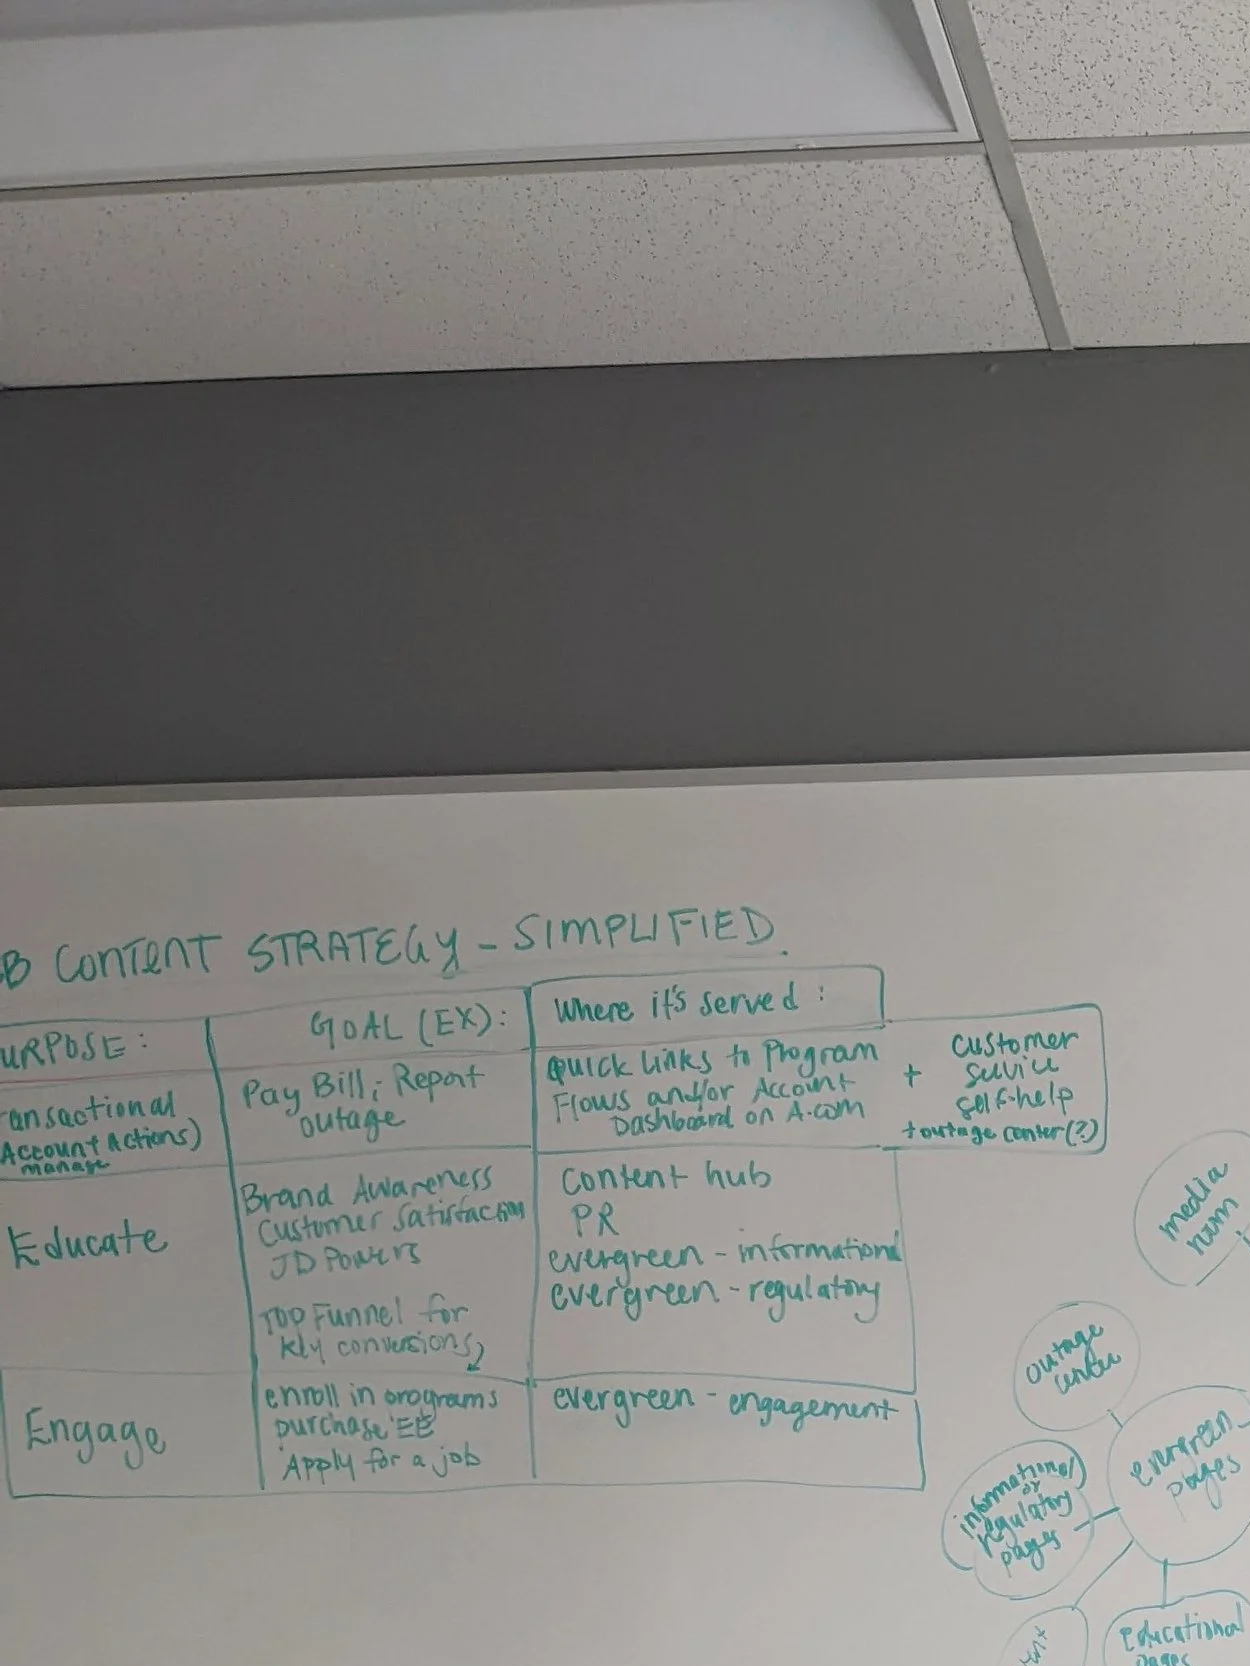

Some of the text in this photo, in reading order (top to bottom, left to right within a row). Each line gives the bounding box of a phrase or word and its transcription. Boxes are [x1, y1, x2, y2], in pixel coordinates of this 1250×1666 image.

[247, 925, 459, 980] STRATEGY
[311, 1010, 405, 1049] GOAL
[0, 1031, 147, 1070] URPOSE:
[242, 1078, 301, 1117] Pay
[394, 1061, 486, 1095] Report
[752, 1072, 857, 1105] Account
[610, 1104, 735, 1138] Dashboard
[745, 1105, 774, 1126] on
[240, 1164, 494, 1217] Brand Awareness
[706, 1160, 773, 1190] hub
[257, 1209, 385, 1248] Customer
[570, 1201, 620, 1238] PR
[6, 1218, 170, 1270] Educate
[269, 1250, 318, 1282] JD
[311, 1295, 403, 1333] Funnel
[418, 1292, 470, 1326] for
[264, 1382, 340, 1410] enroll
[350, 1382, 377, 1408] in
[25, 1406, 167, 1471] Engage
[282, 1441, 482, 1485] Apply for a job
